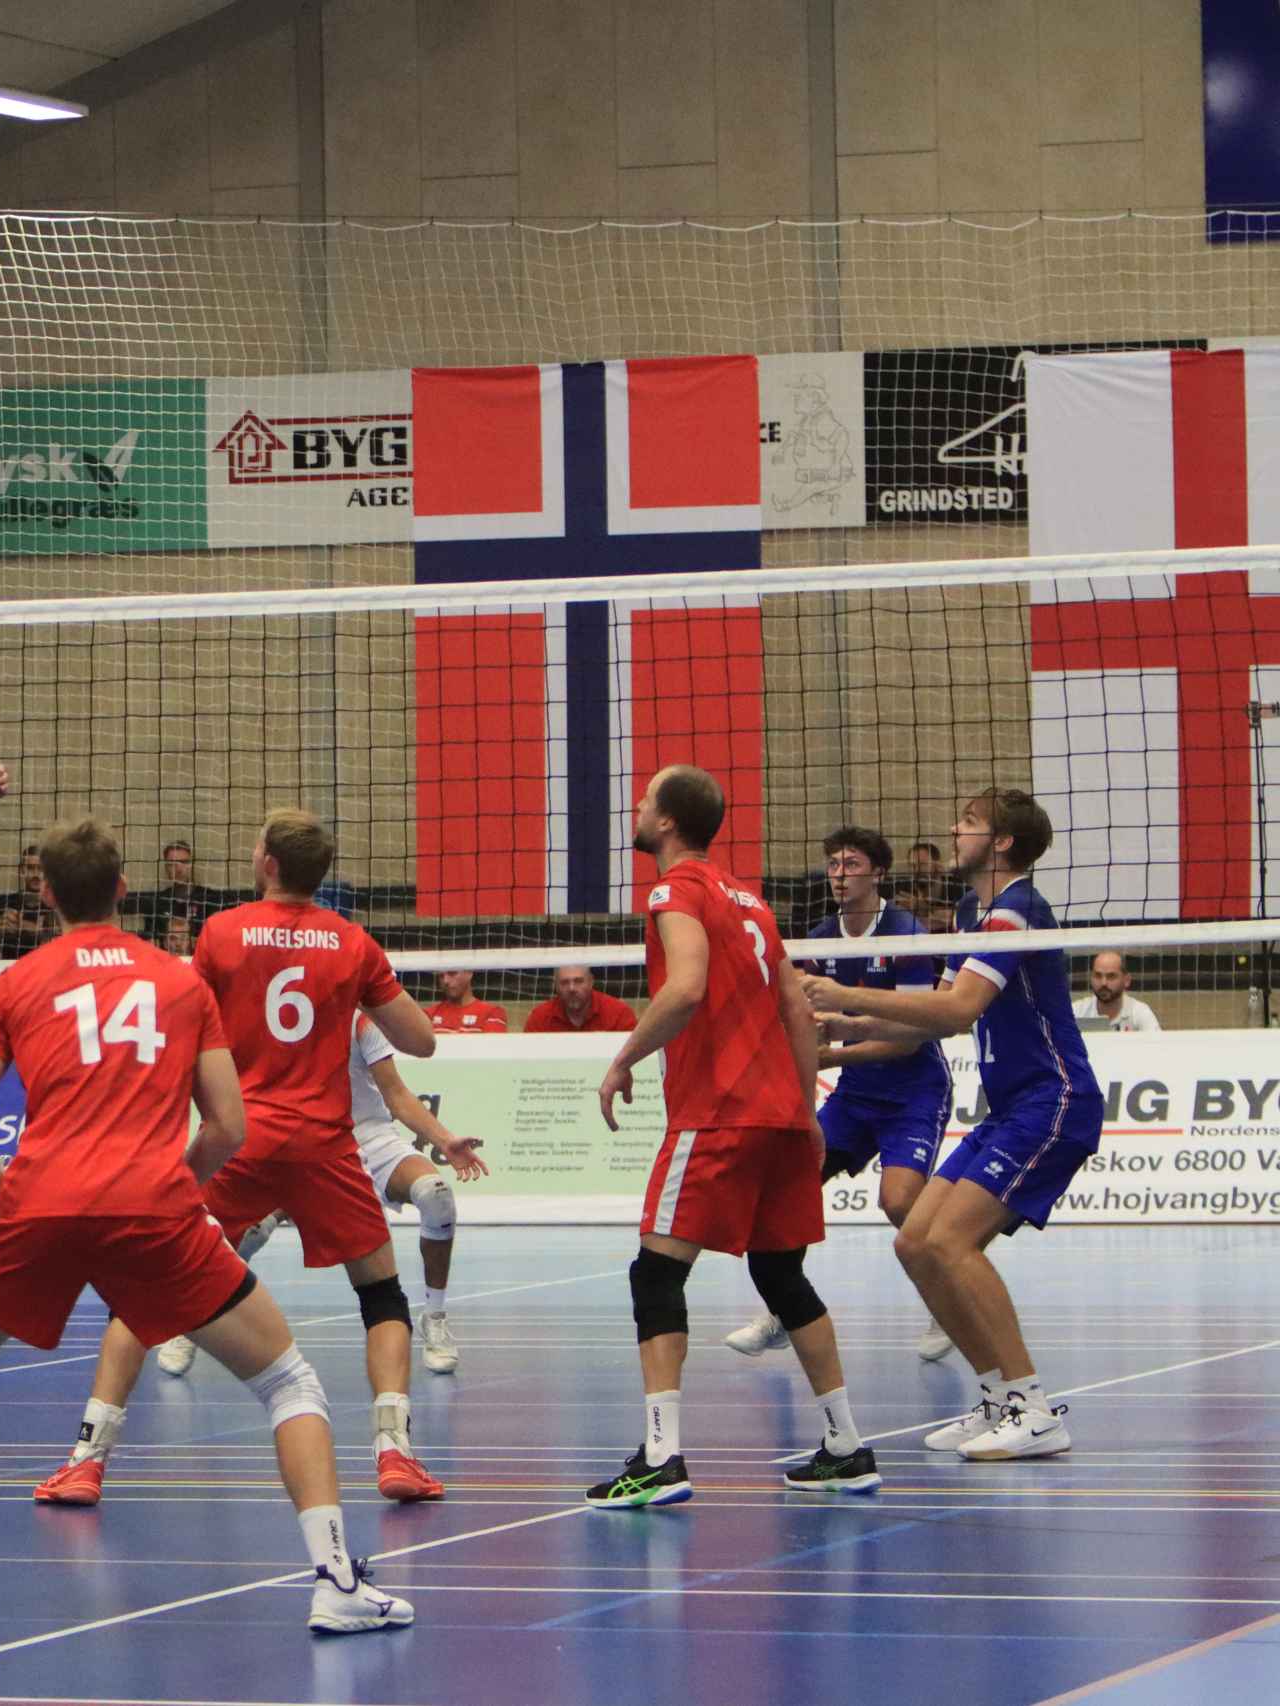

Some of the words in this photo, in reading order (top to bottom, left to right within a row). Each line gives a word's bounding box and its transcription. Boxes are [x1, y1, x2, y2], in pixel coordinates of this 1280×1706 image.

[293, 427, 408, 469] BYG
[880, 487, 1013, 512] GRINDSTED
[242, 927, 340, 950] MIKELSONS
[75, 948, 135, 967] DAHL
[265, 966, 314, 1043] 6
[54, 980, 166, 1064] 14
[1193, 1079, 1280, 1121] BY
[1174, 1149, 1246, 1172] 6800
[831, 1189, 868, 1211] 35
